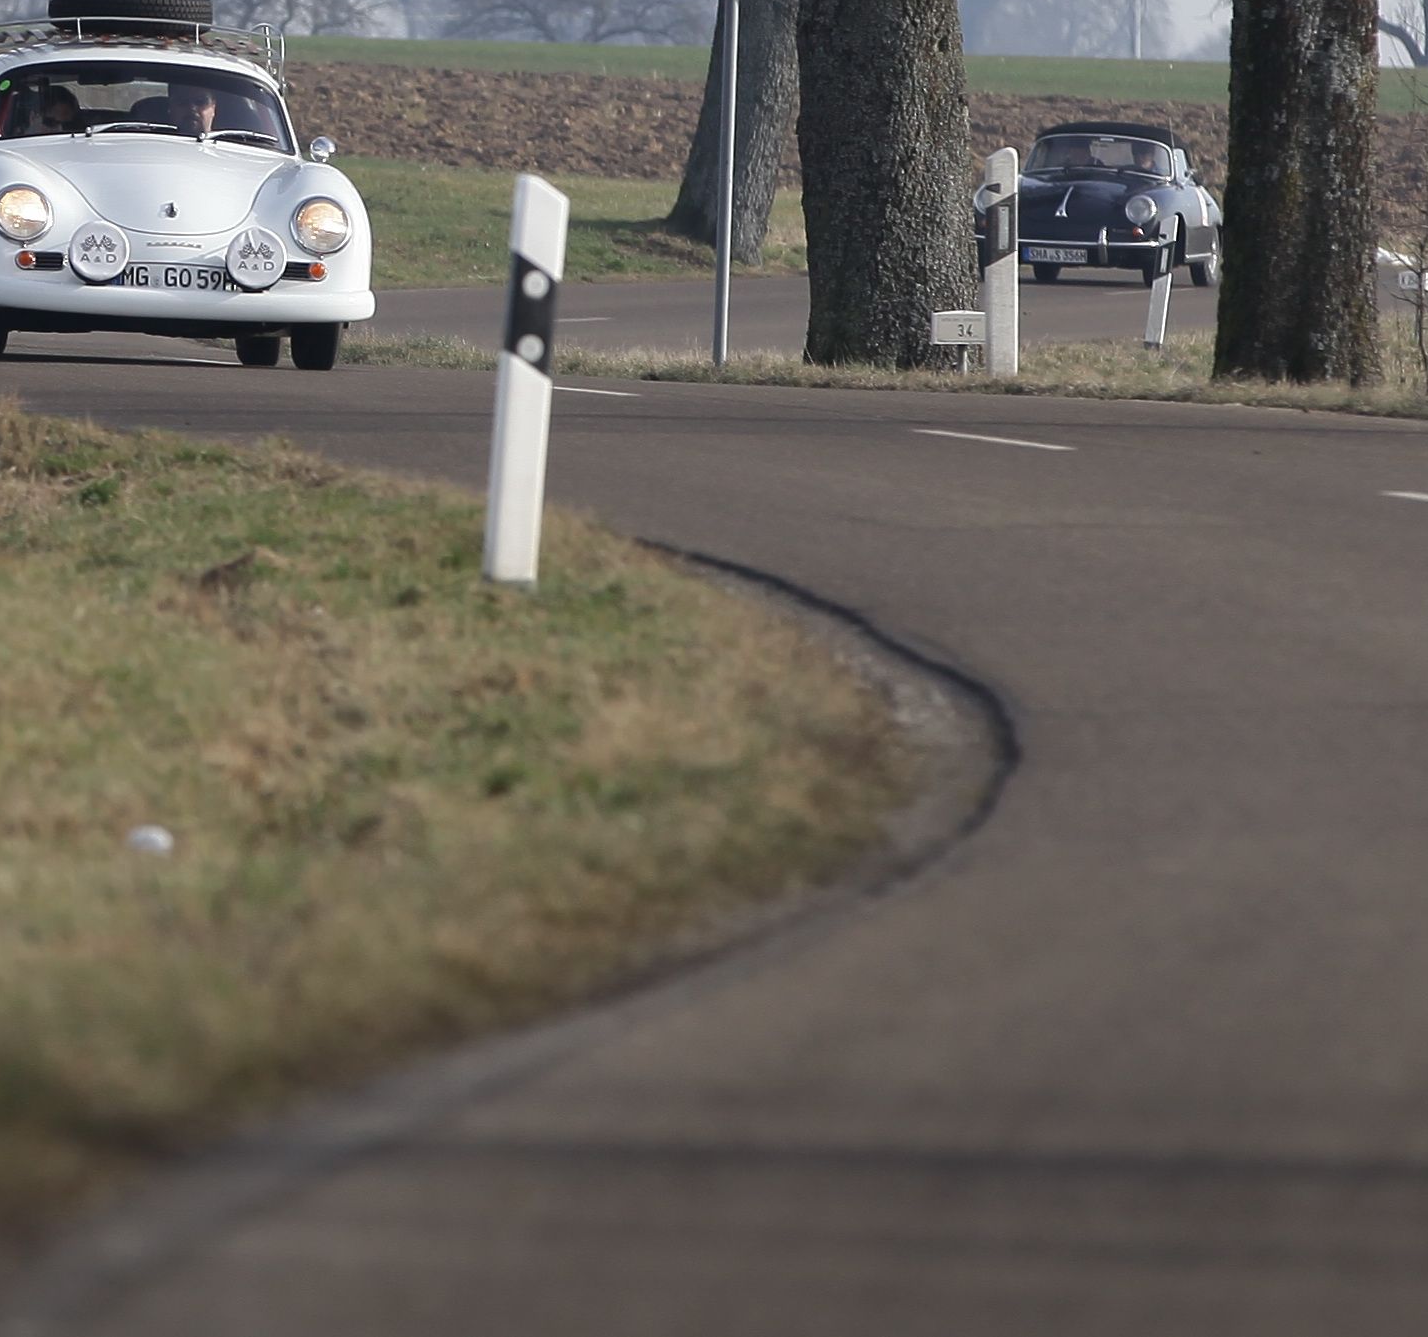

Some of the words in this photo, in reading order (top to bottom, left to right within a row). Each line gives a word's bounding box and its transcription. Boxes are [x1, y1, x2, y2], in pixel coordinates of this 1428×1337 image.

[80, 253, 91, 263] A
[93, 255, 102, 263] &
[105, 253, 117, 263] D
[237, 260, 249, 270] A
[263, 261, 275, 271] D
[122, 266, 149, 286] MG
[957, 324, 973, 337] 34
